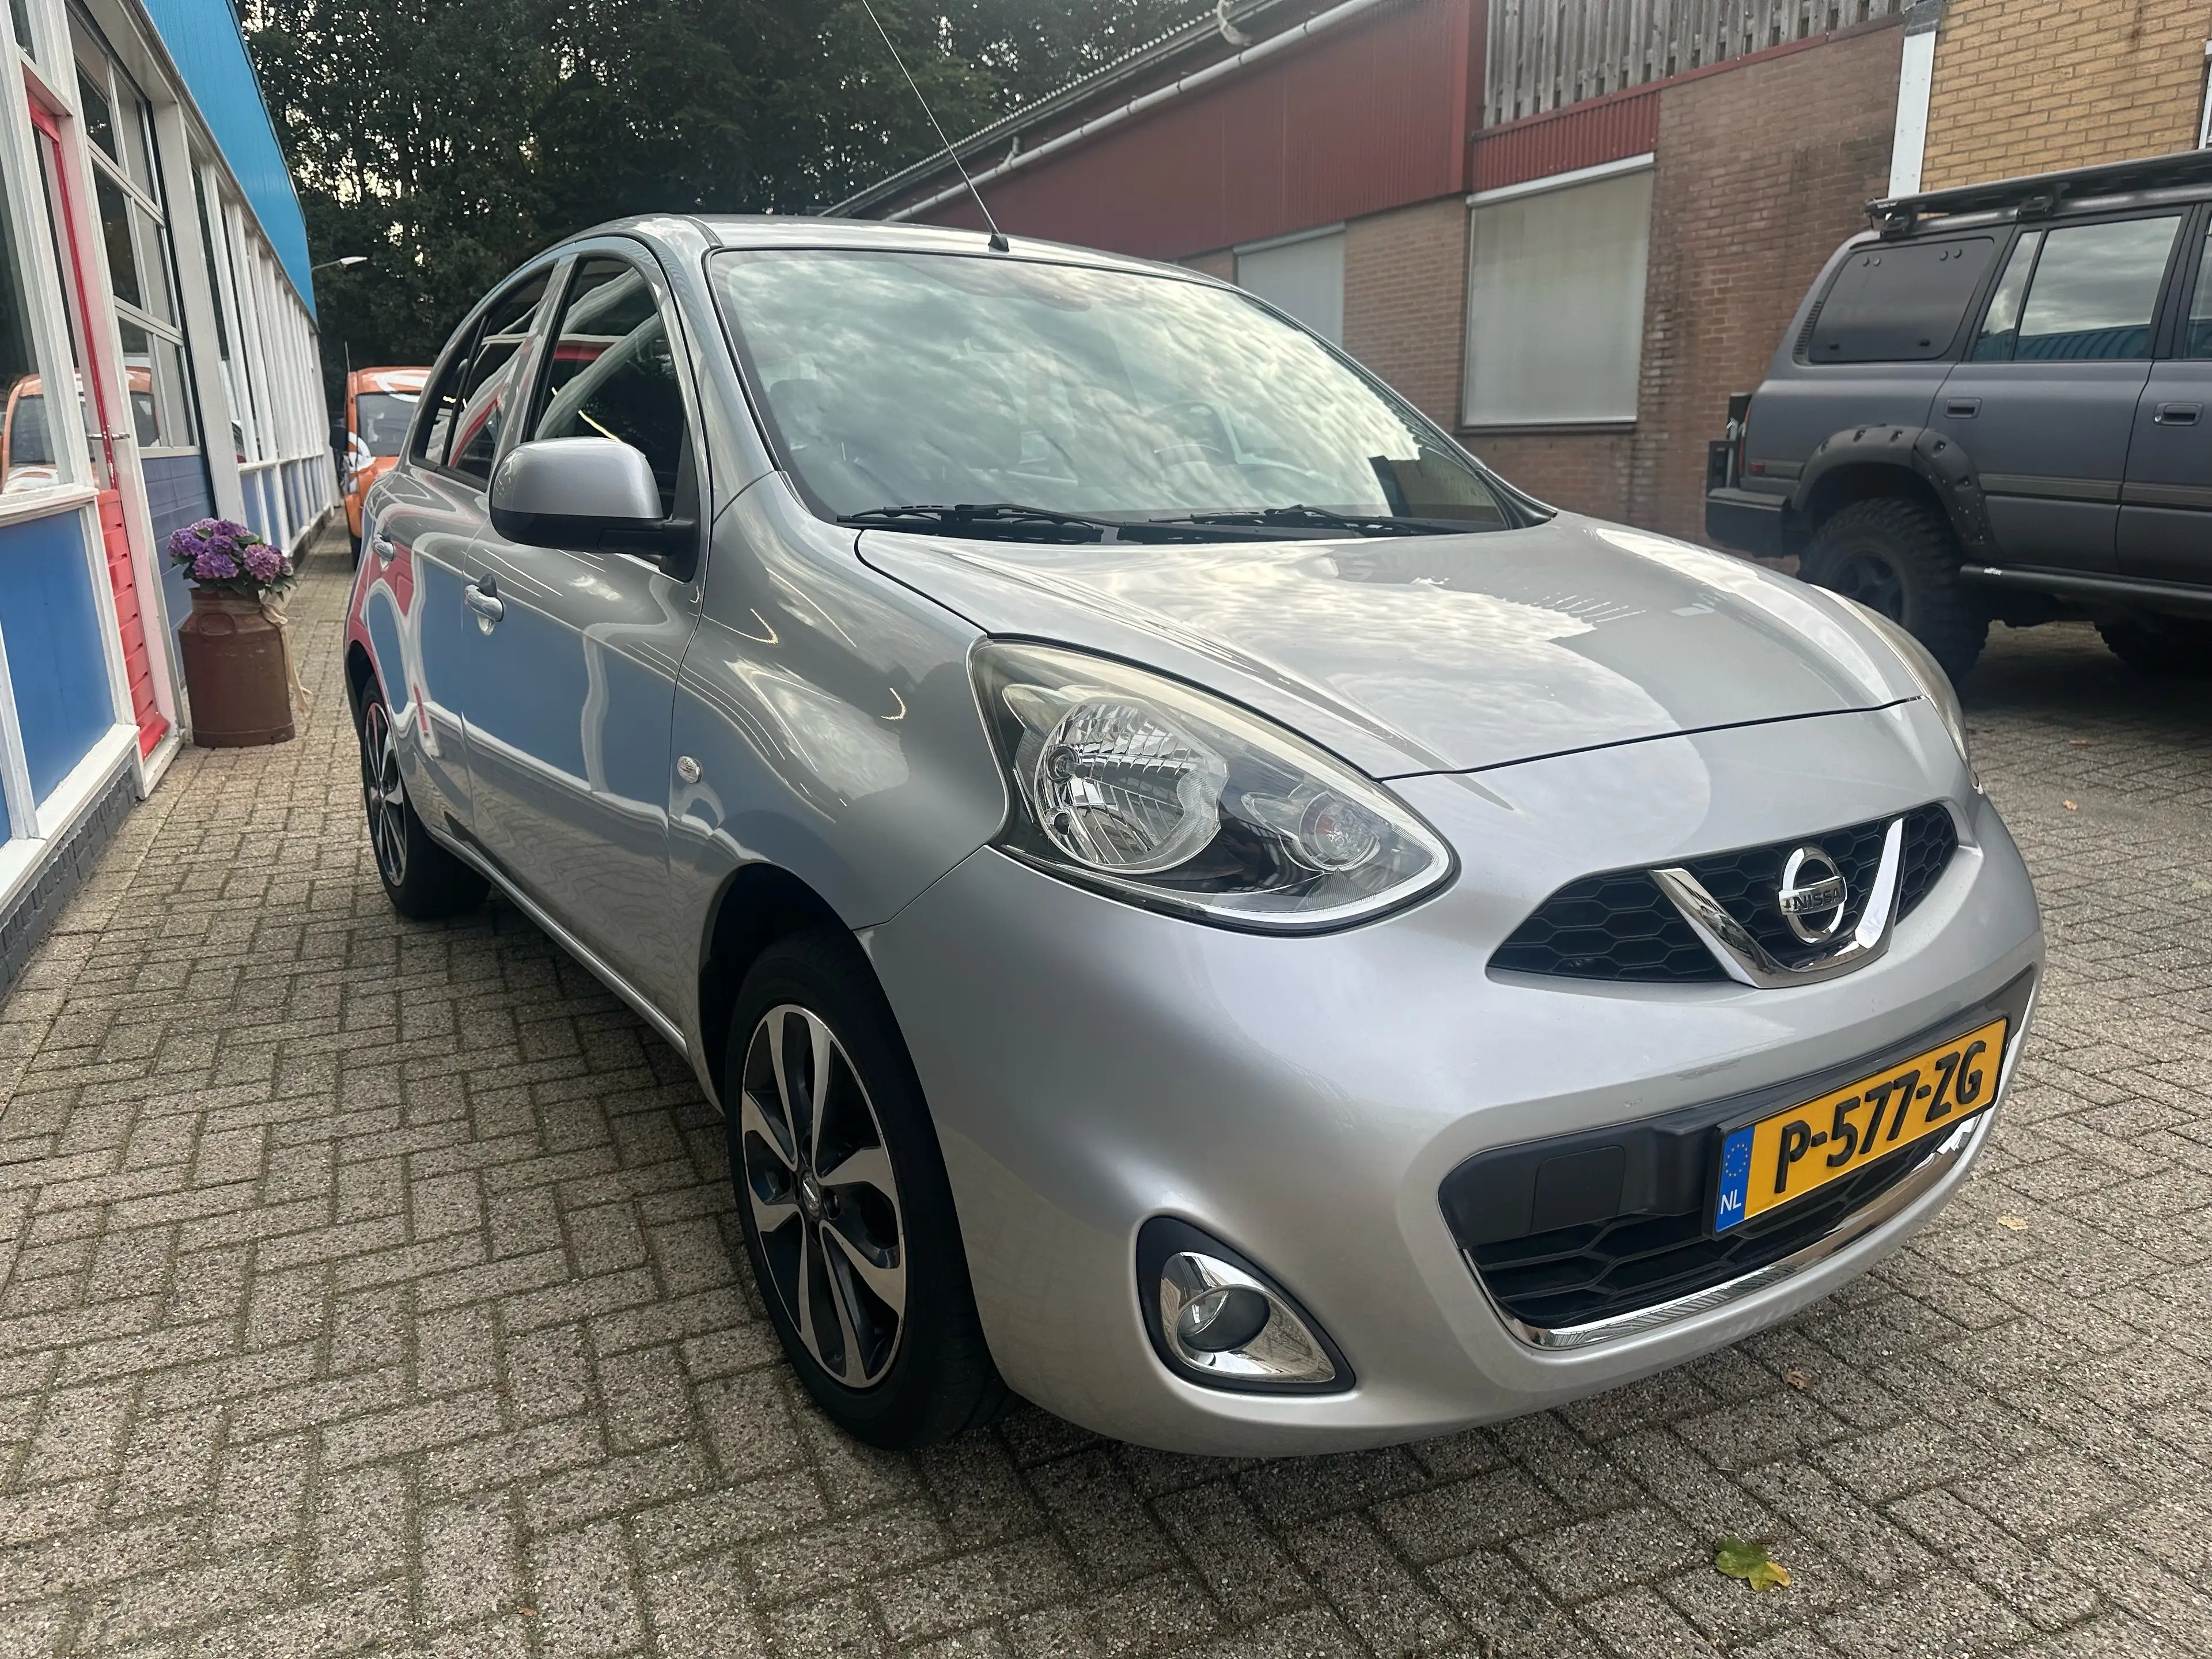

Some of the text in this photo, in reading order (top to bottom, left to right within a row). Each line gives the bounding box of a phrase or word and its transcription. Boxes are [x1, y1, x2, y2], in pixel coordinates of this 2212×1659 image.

[1793, 884, 1845, 910] NISSA
[1775, 1040, 1986, 1194] P-577-ZG
[1720, 1189, 1742, 1215] NL
